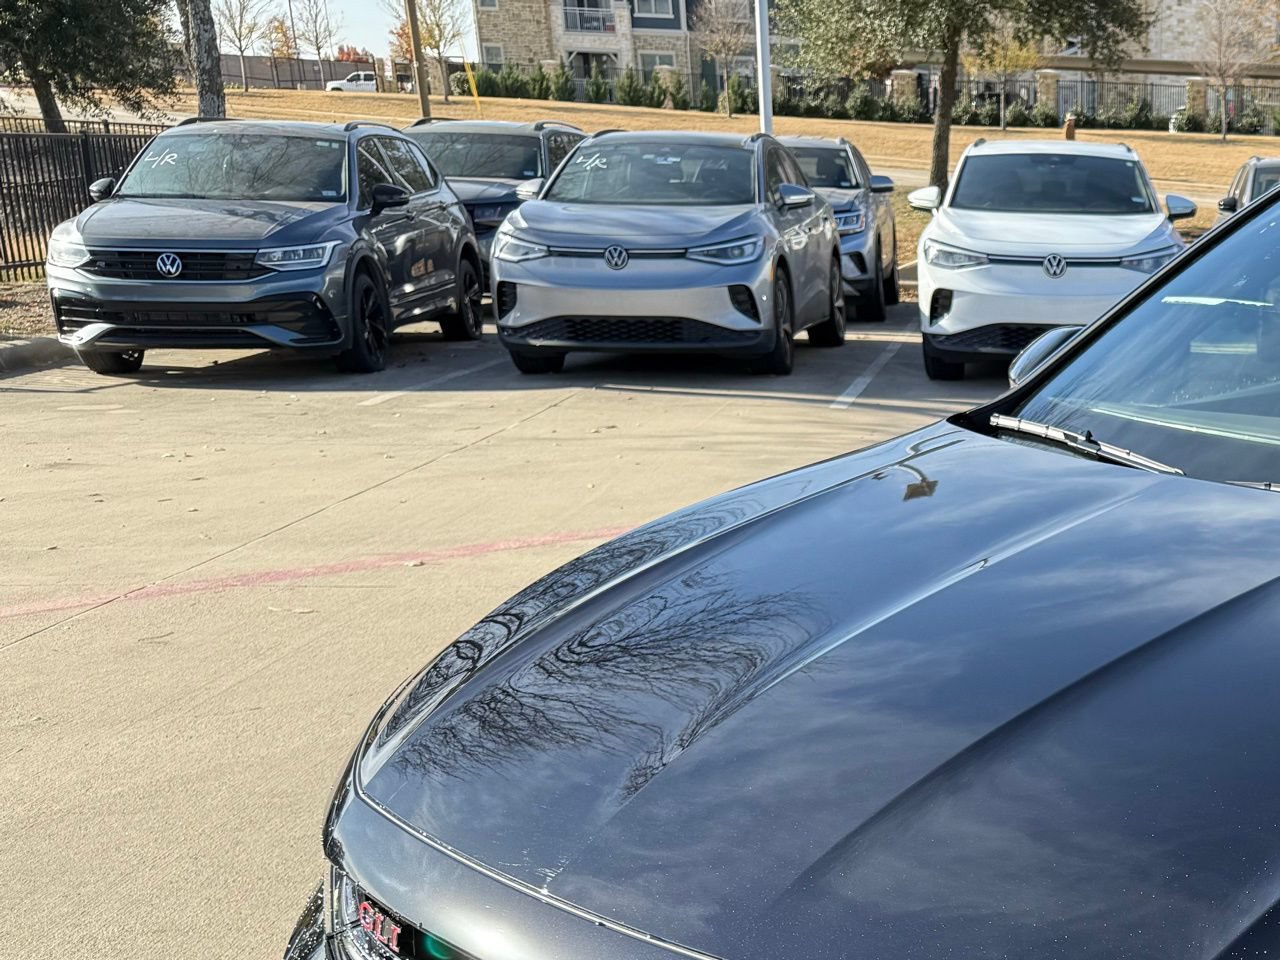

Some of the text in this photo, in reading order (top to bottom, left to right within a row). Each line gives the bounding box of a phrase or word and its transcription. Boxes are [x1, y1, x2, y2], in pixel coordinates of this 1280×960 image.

[156, 252, 182, 278] VW
[605, 245, 629, 270] VW
[1043, 253, 1067, 279] VW
[360, 901, 401, 953] GLI
